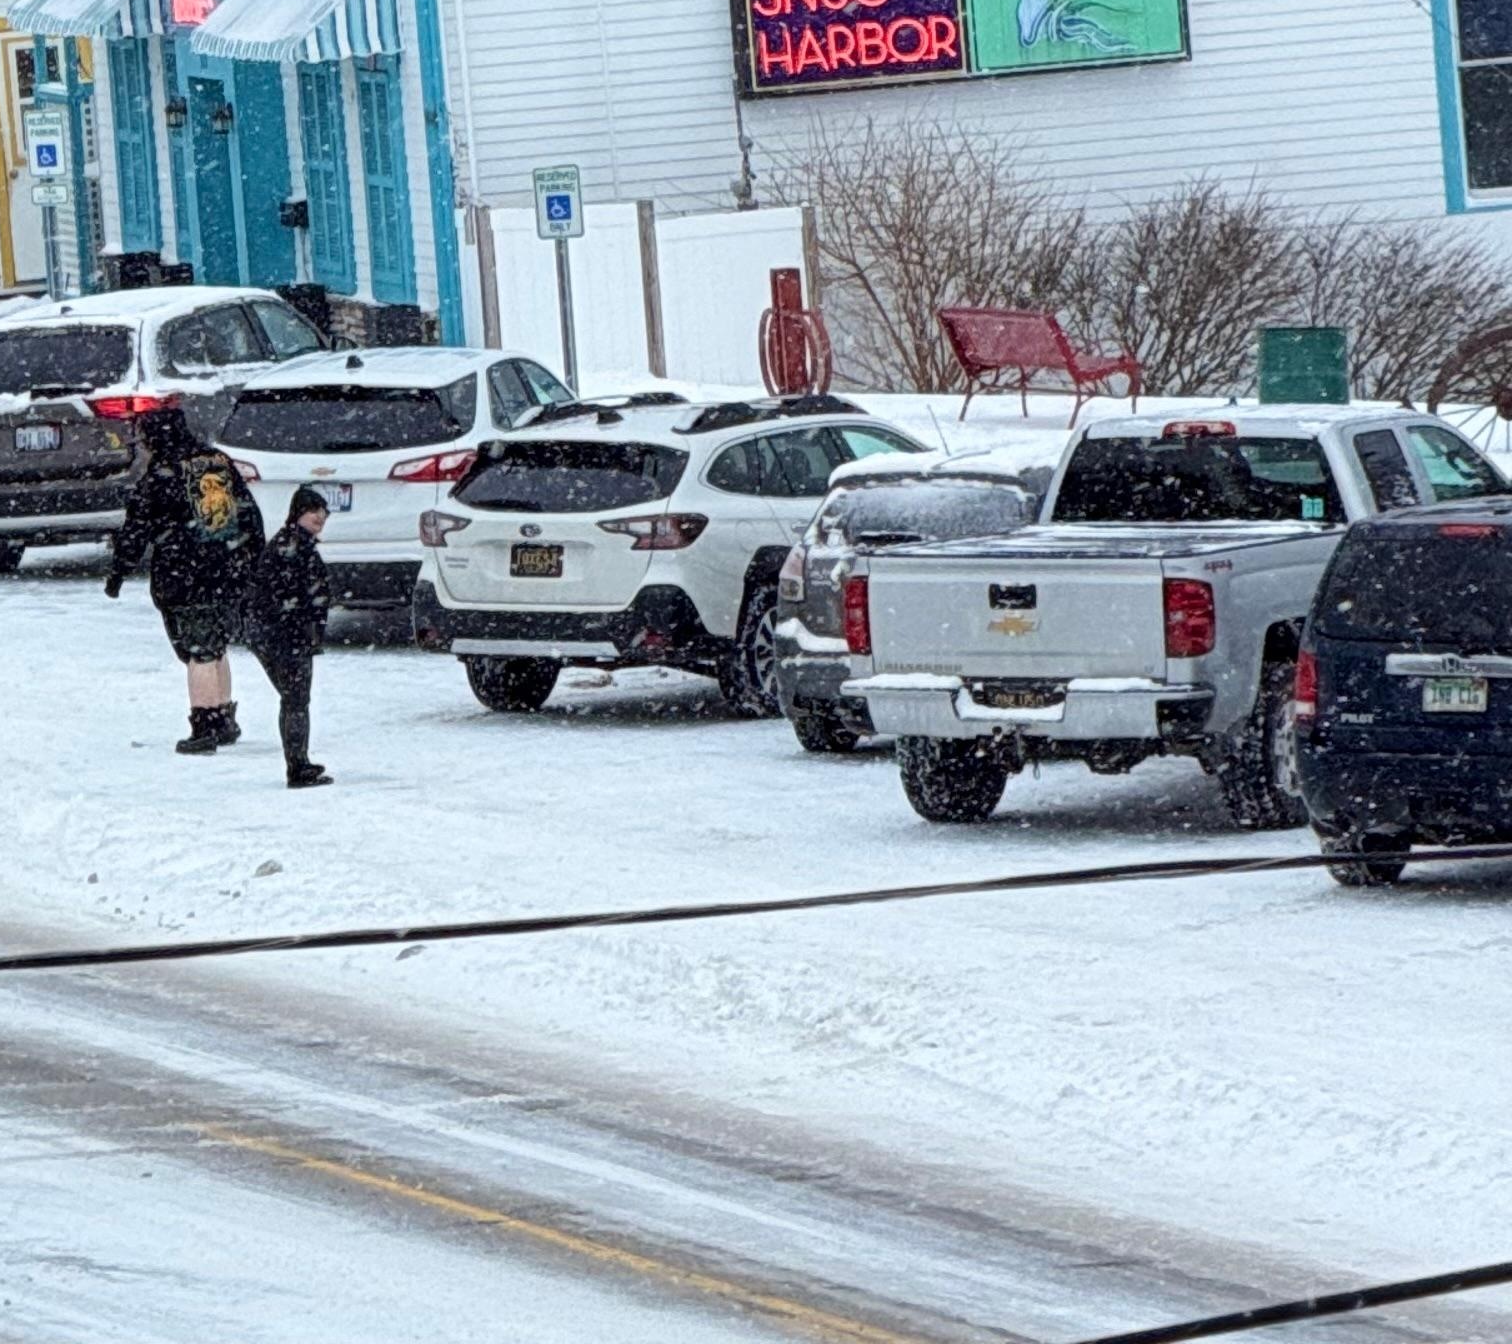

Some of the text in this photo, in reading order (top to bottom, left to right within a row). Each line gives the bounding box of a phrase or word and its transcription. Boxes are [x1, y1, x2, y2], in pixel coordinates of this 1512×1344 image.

[757, 14, 957, 77] HARBOR
[30, 128, 59, 136] PARKING
[536, 171, 577, 182] RESERVED
[539, 183, 575, 194] PARKING
[550, 222, 571, 232] ONLY
[1340, 713, 1375, 724] PILOT
